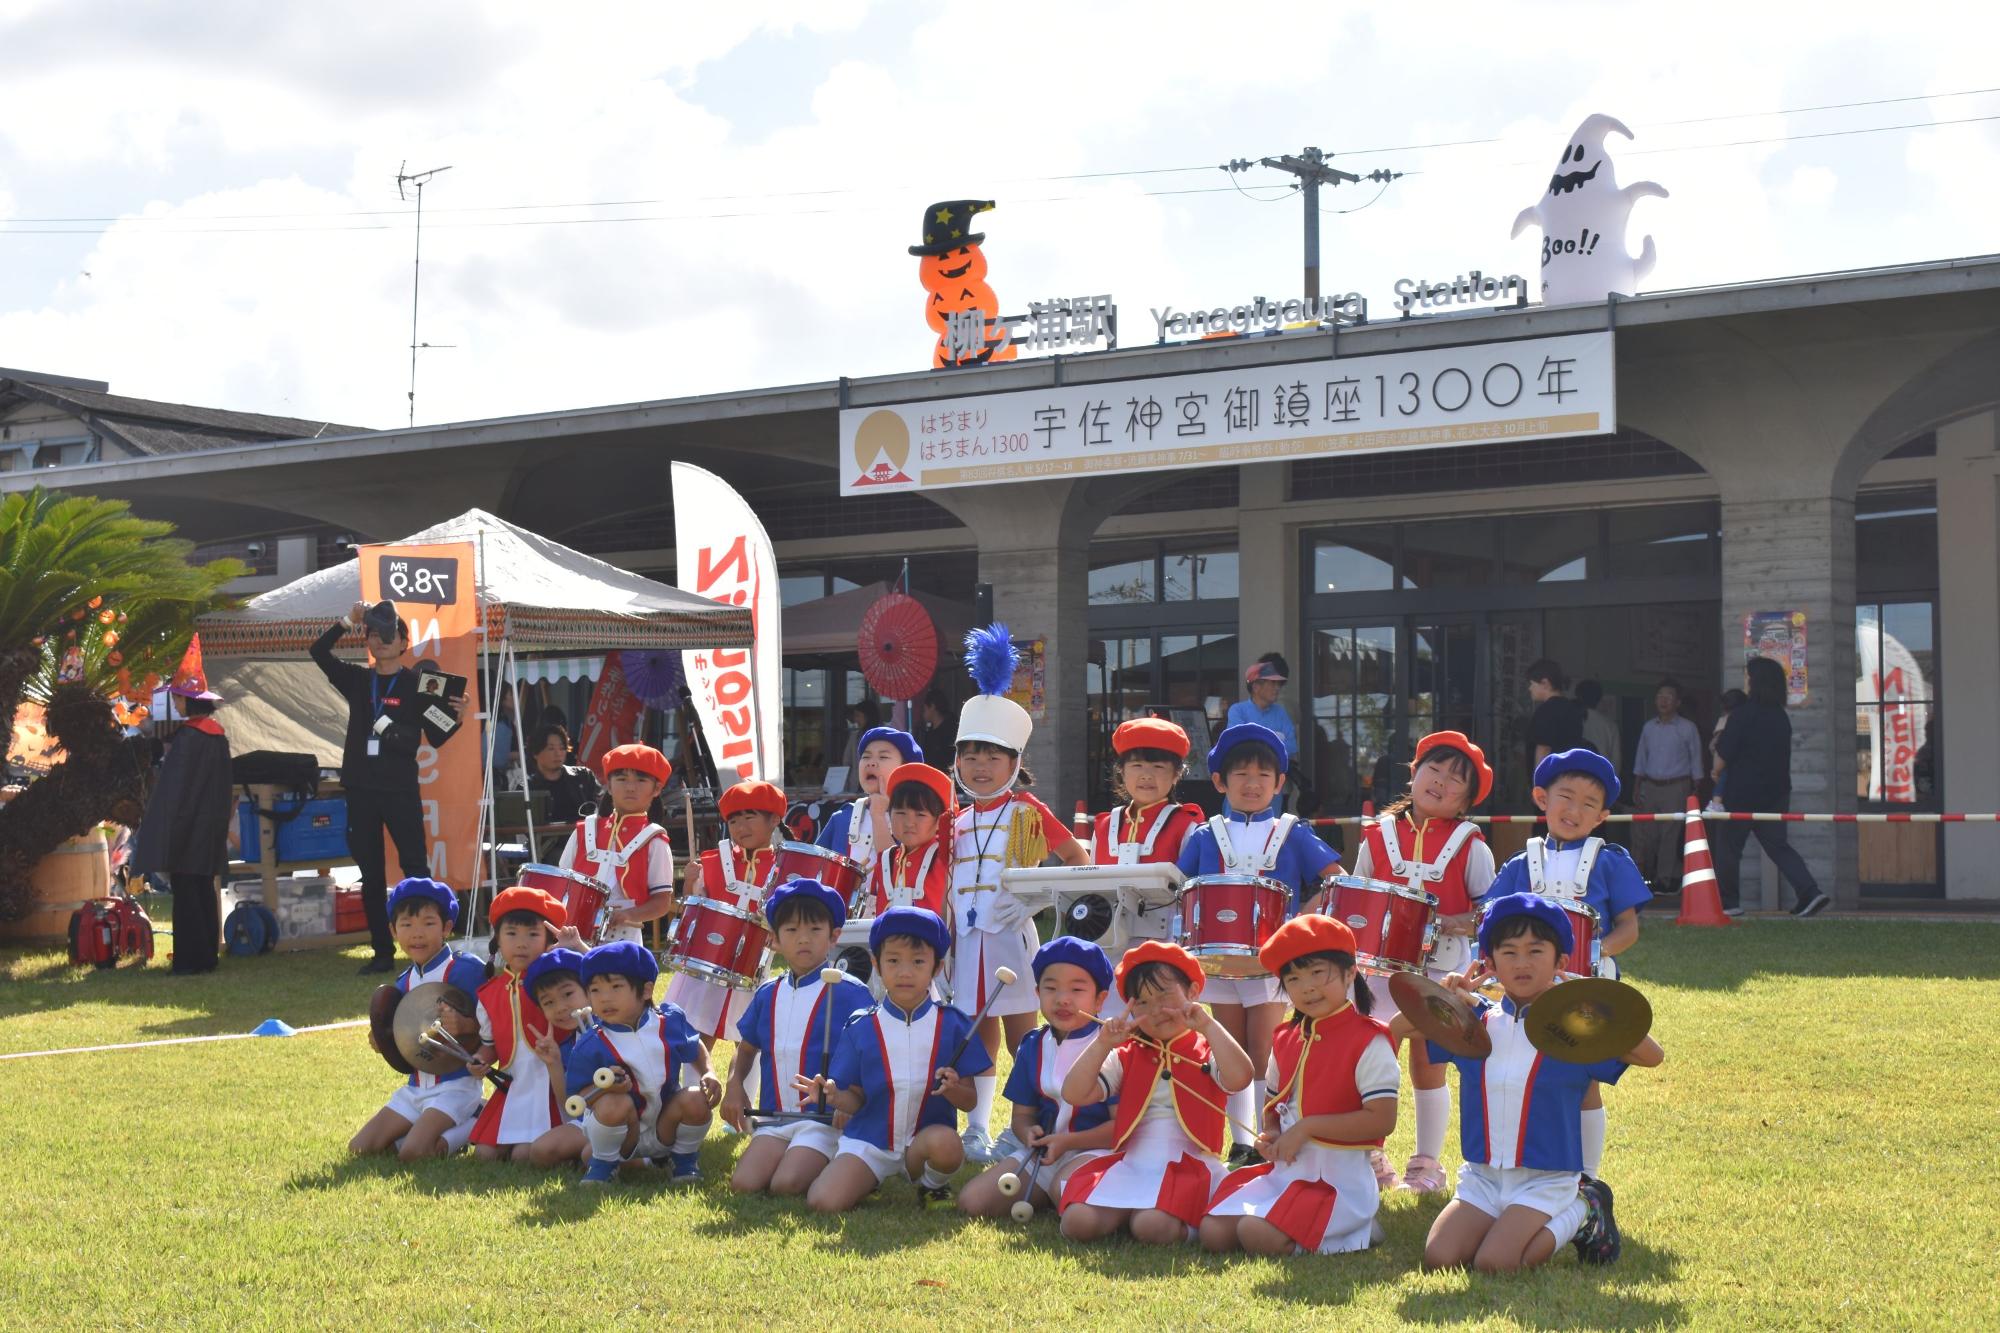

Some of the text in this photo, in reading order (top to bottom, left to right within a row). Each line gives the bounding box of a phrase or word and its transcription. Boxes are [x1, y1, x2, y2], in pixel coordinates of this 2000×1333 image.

[1150, 271, 1523, 337] Yanagigaura Station
[919, 432, 1029, 461] はちまん1300
